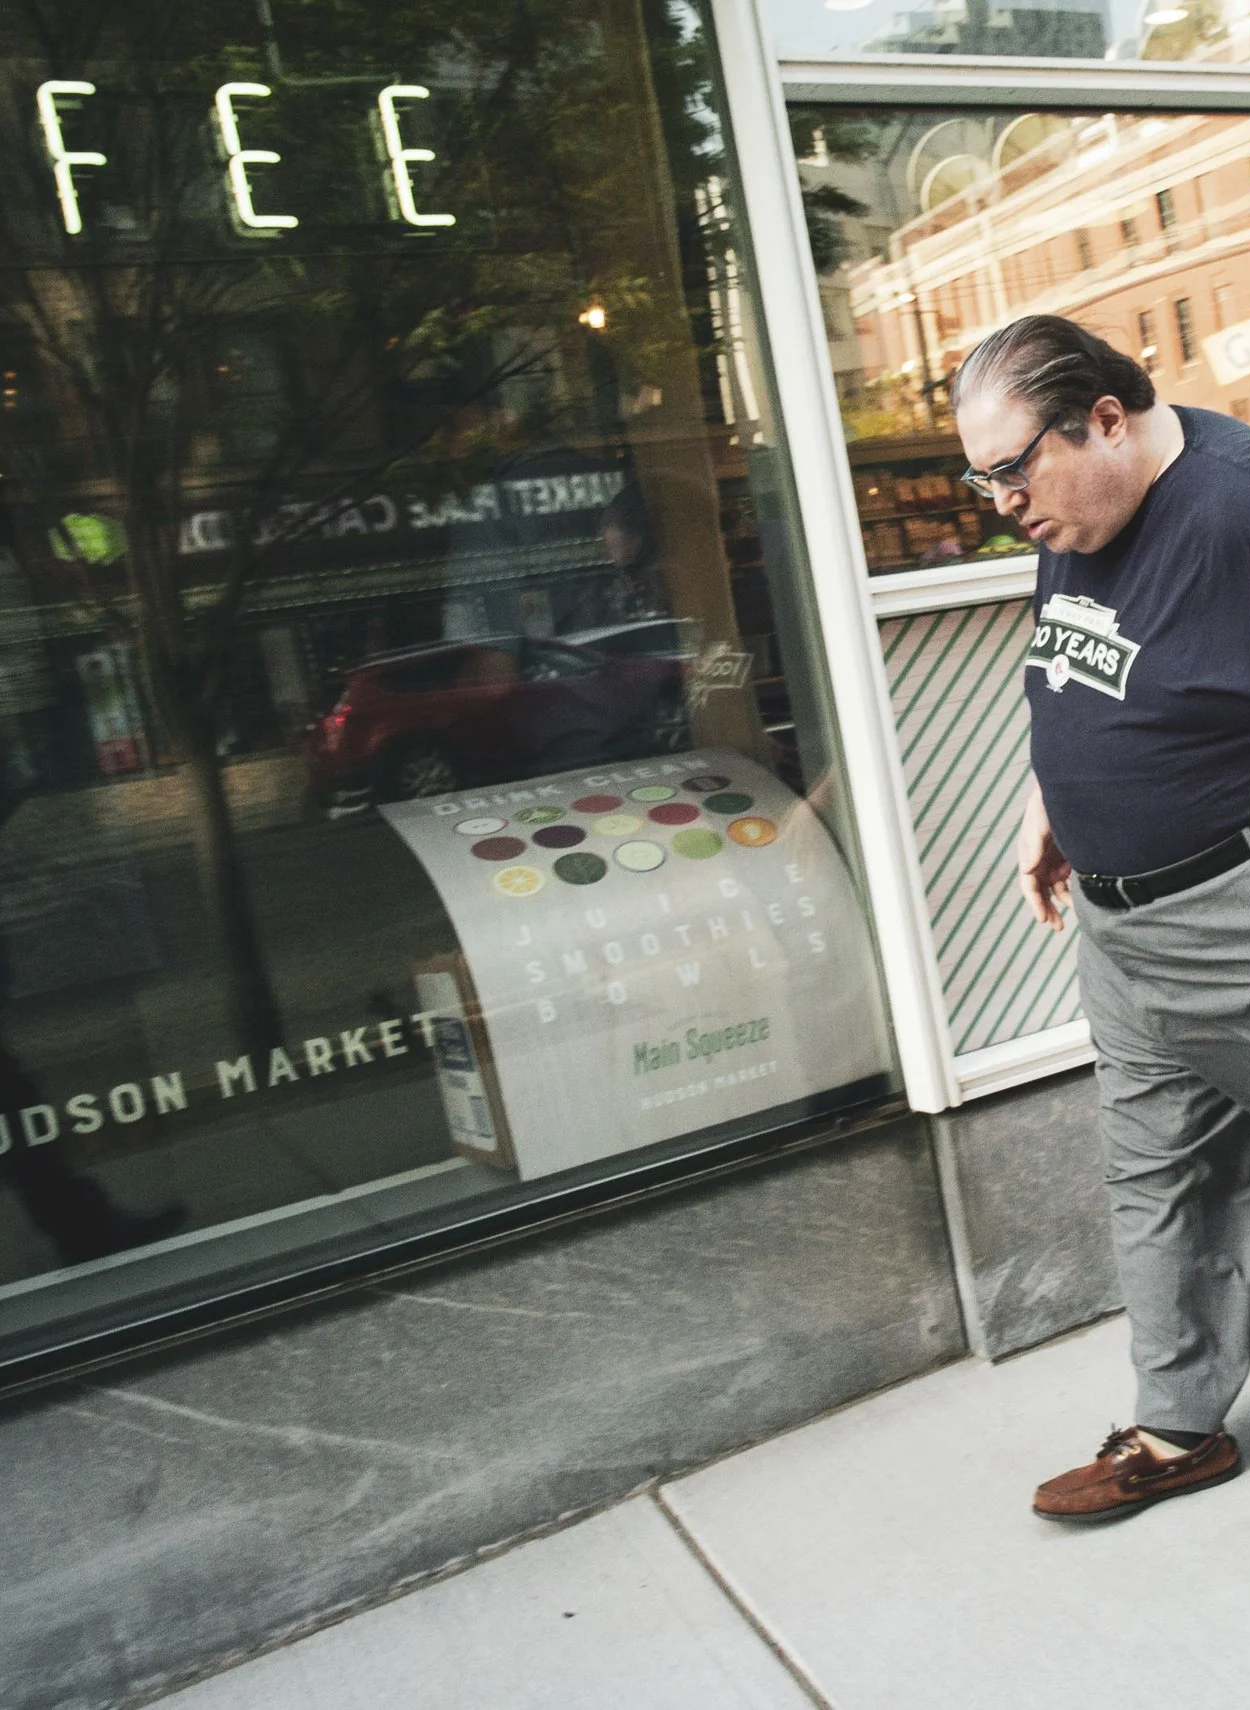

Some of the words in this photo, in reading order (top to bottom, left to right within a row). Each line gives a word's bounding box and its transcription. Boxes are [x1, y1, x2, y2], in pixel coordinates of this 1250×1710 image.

[37, 80, 457, 235] FEE
[1054, 627, 1121, 676] YEARS
[583, 758, 710, 788] CLEAN
[515, 863, 804, 948] JUICE
[524, 896, 816, 984] SMOOTHIES
[536, 931, 827, 1025] BOWLS
[215, 1011, 441, 1099] MARKET
[633, 1040, 681, 1076] Main
[685, 1017, 771, 1064] Squeeze
